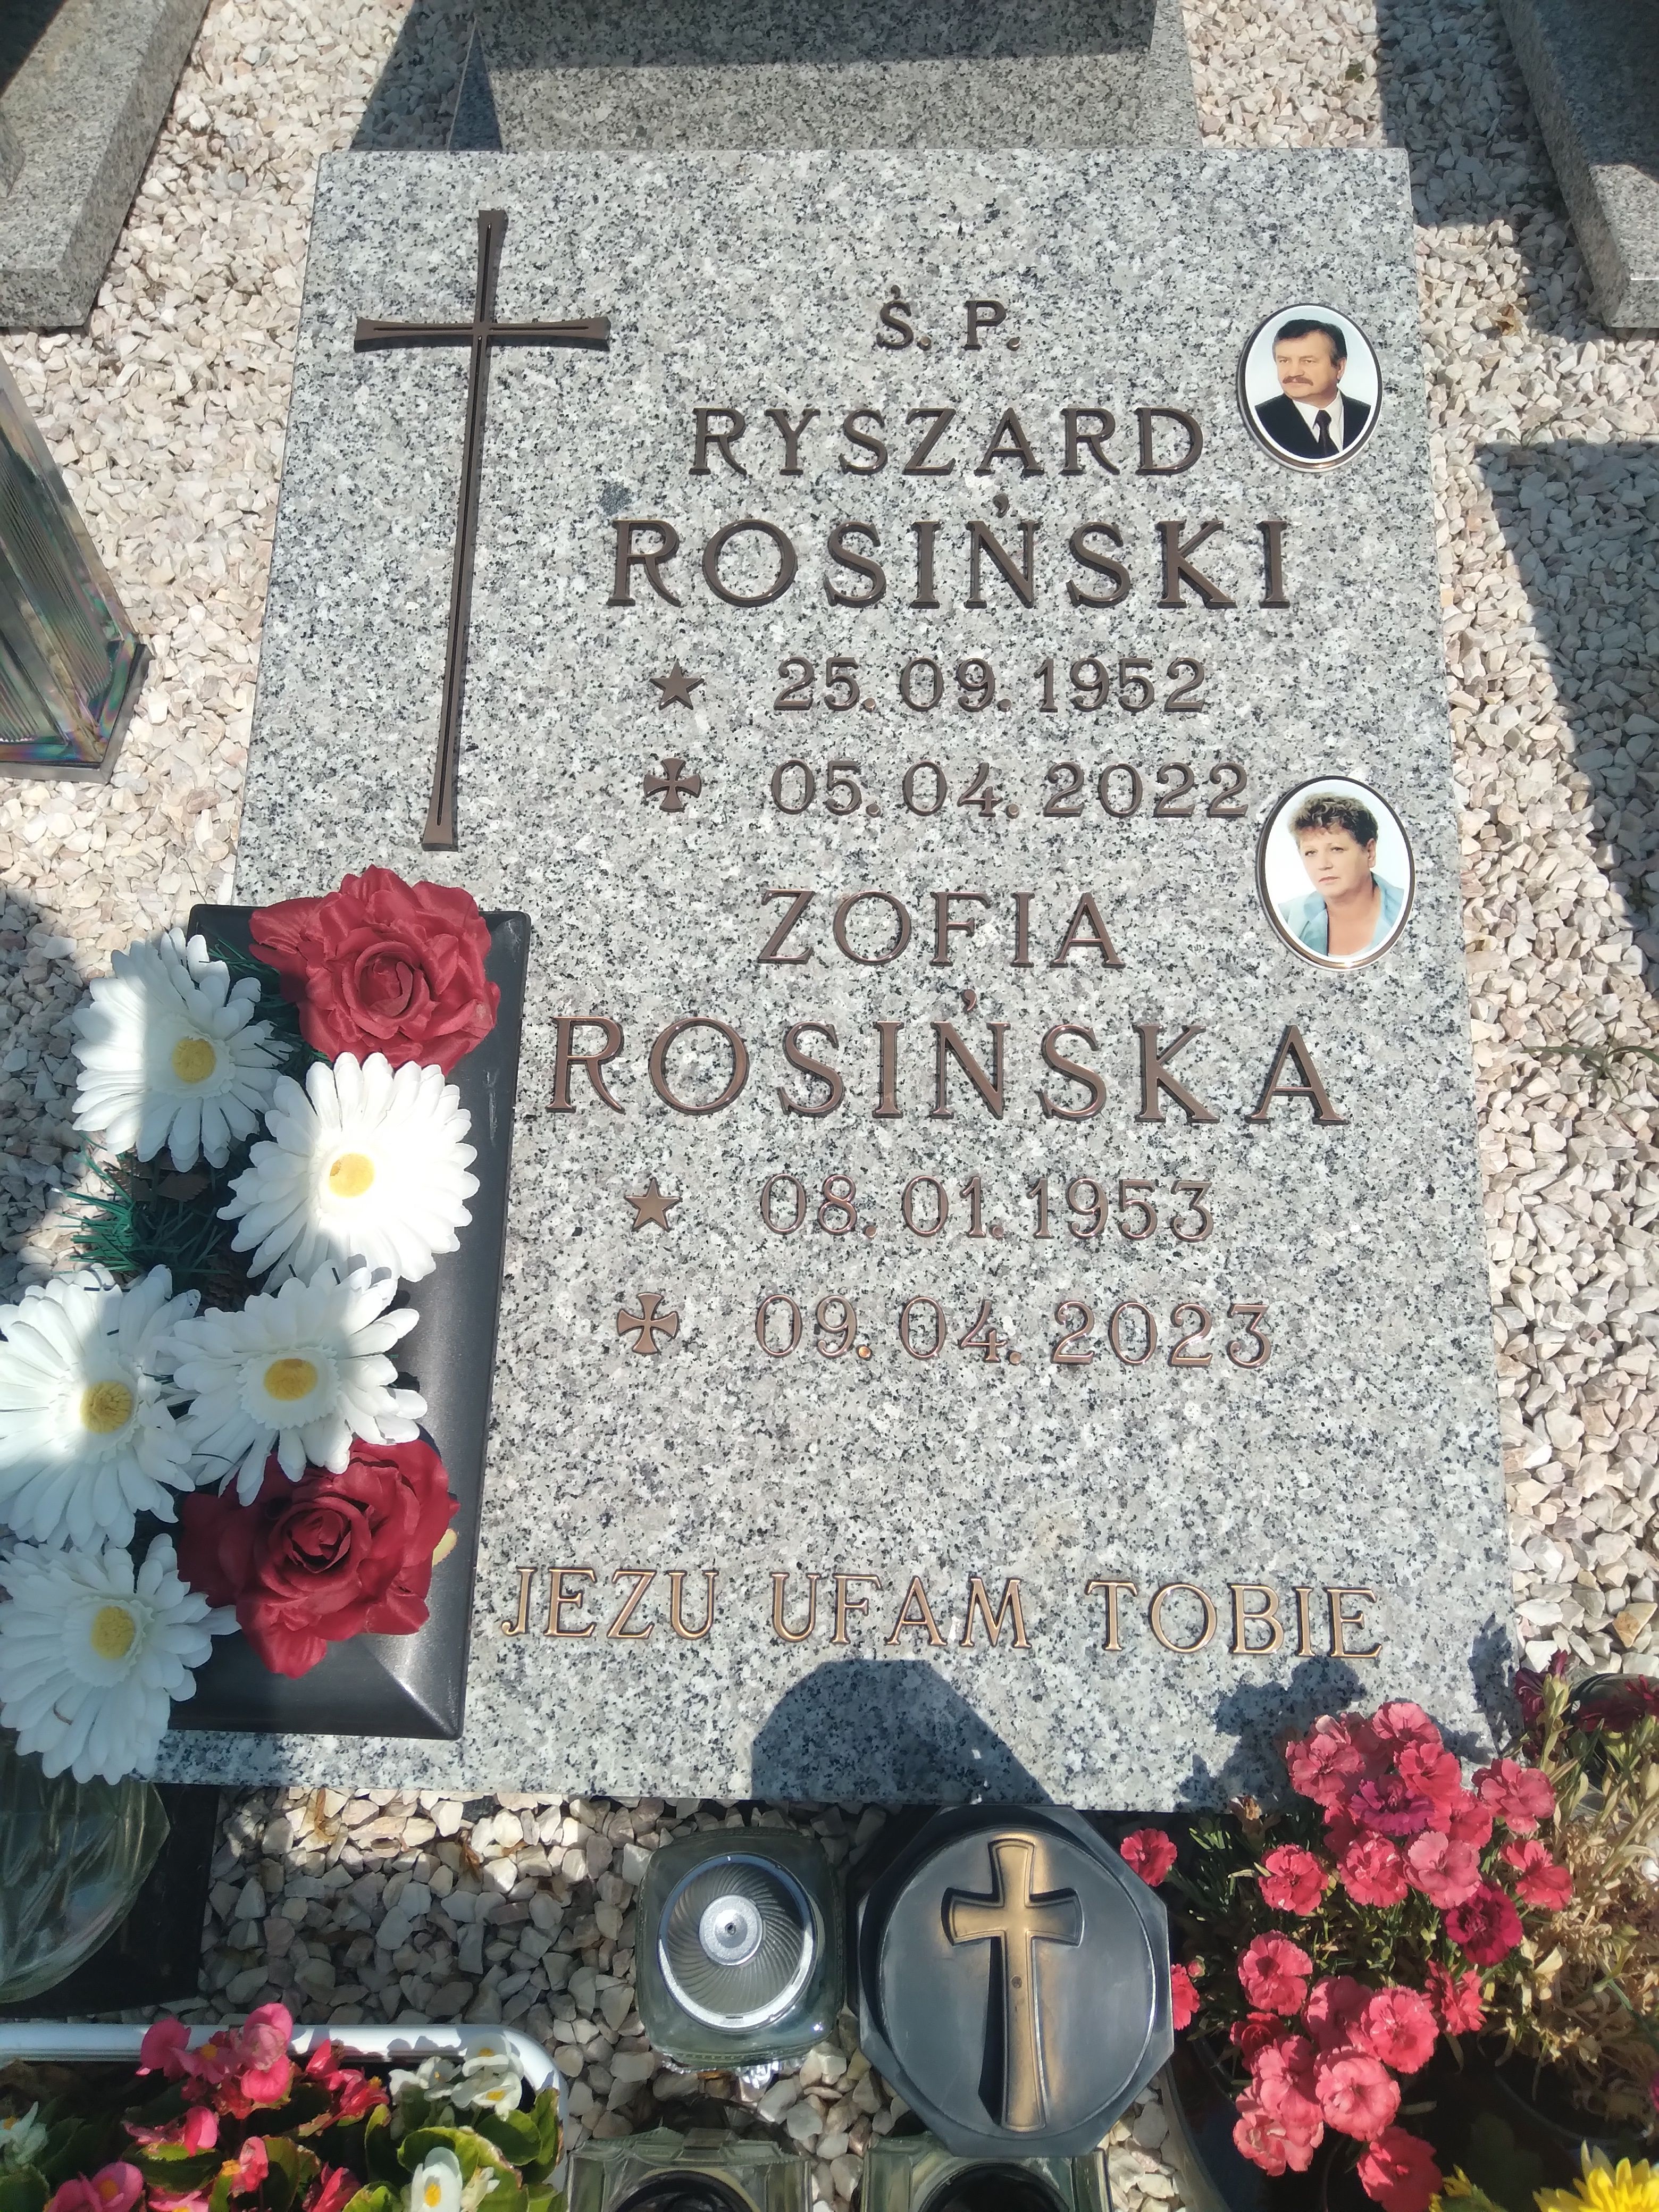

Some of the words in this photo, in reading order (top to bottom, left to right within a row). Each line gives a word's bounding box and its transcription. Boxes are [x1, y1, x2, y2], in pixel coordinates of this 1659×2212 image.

[876, 283, 932, 351] Ś.
[688, 406, 1203, 477] RYSZARD
[606, 492, 1291, 610] ROSIŃSKI
[757, 887, 1126, 969] ZOFIA
[544, 987, 1350, 1126] ROSIŃSKA
[501, 1566, 719, 1640] JEZU
[771, 1571, 1032, 1650] UFAM
[1085, 1580, 1385, 1660] TOBIE
